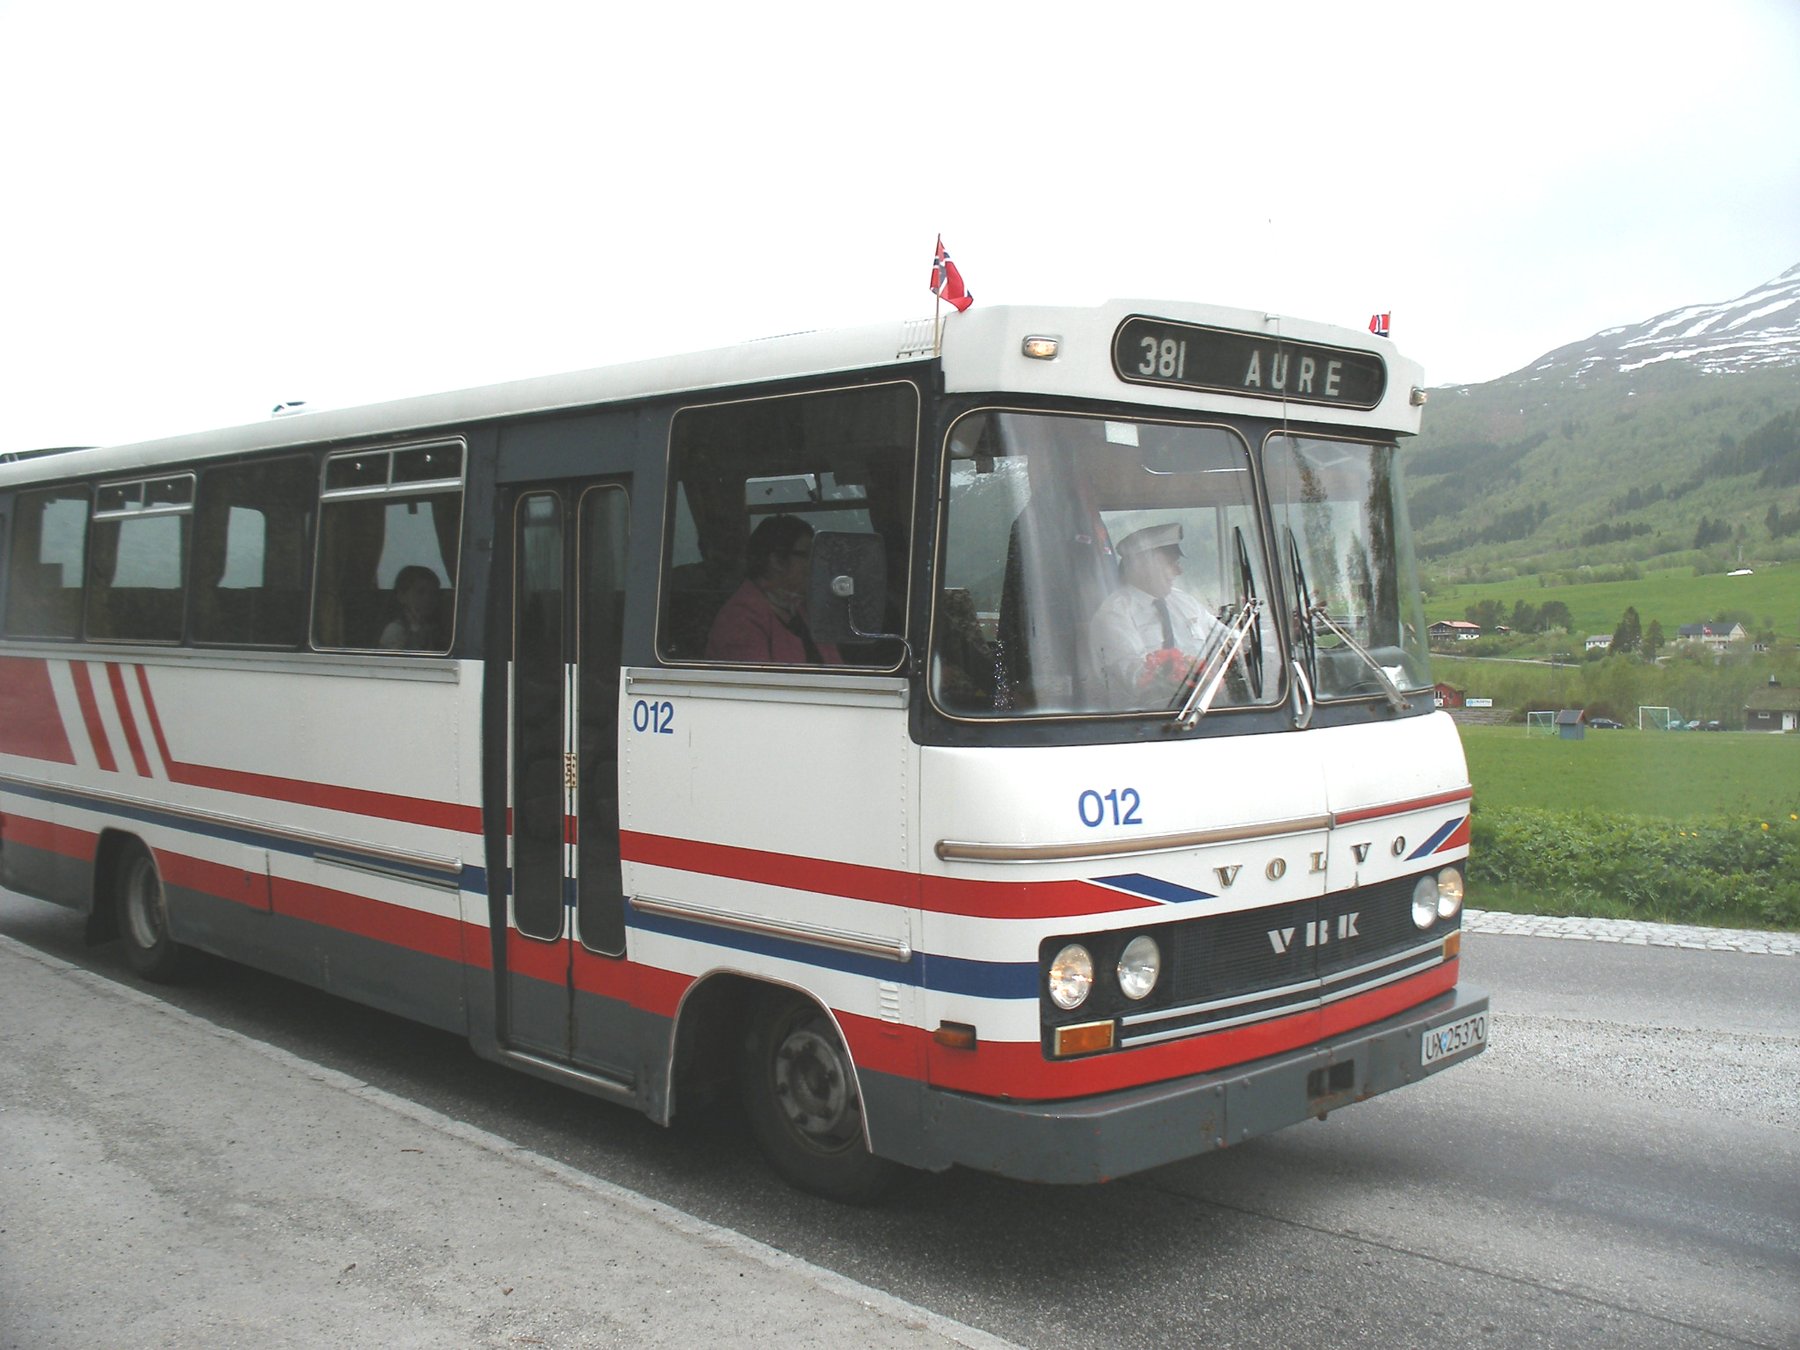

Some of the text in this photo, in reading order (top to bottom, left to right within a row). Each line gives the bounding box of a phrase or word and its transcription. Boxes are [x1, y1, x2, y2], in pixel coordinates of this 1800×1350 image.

[1138, 336, 1342, 396] 381 AURE
[633, 700, 674, 734] 012
[1078, 788, 1143, 828] 012
[1213, 836, 1406, 888] VOLVO
[1267, 912, 1360, 954] VBK
